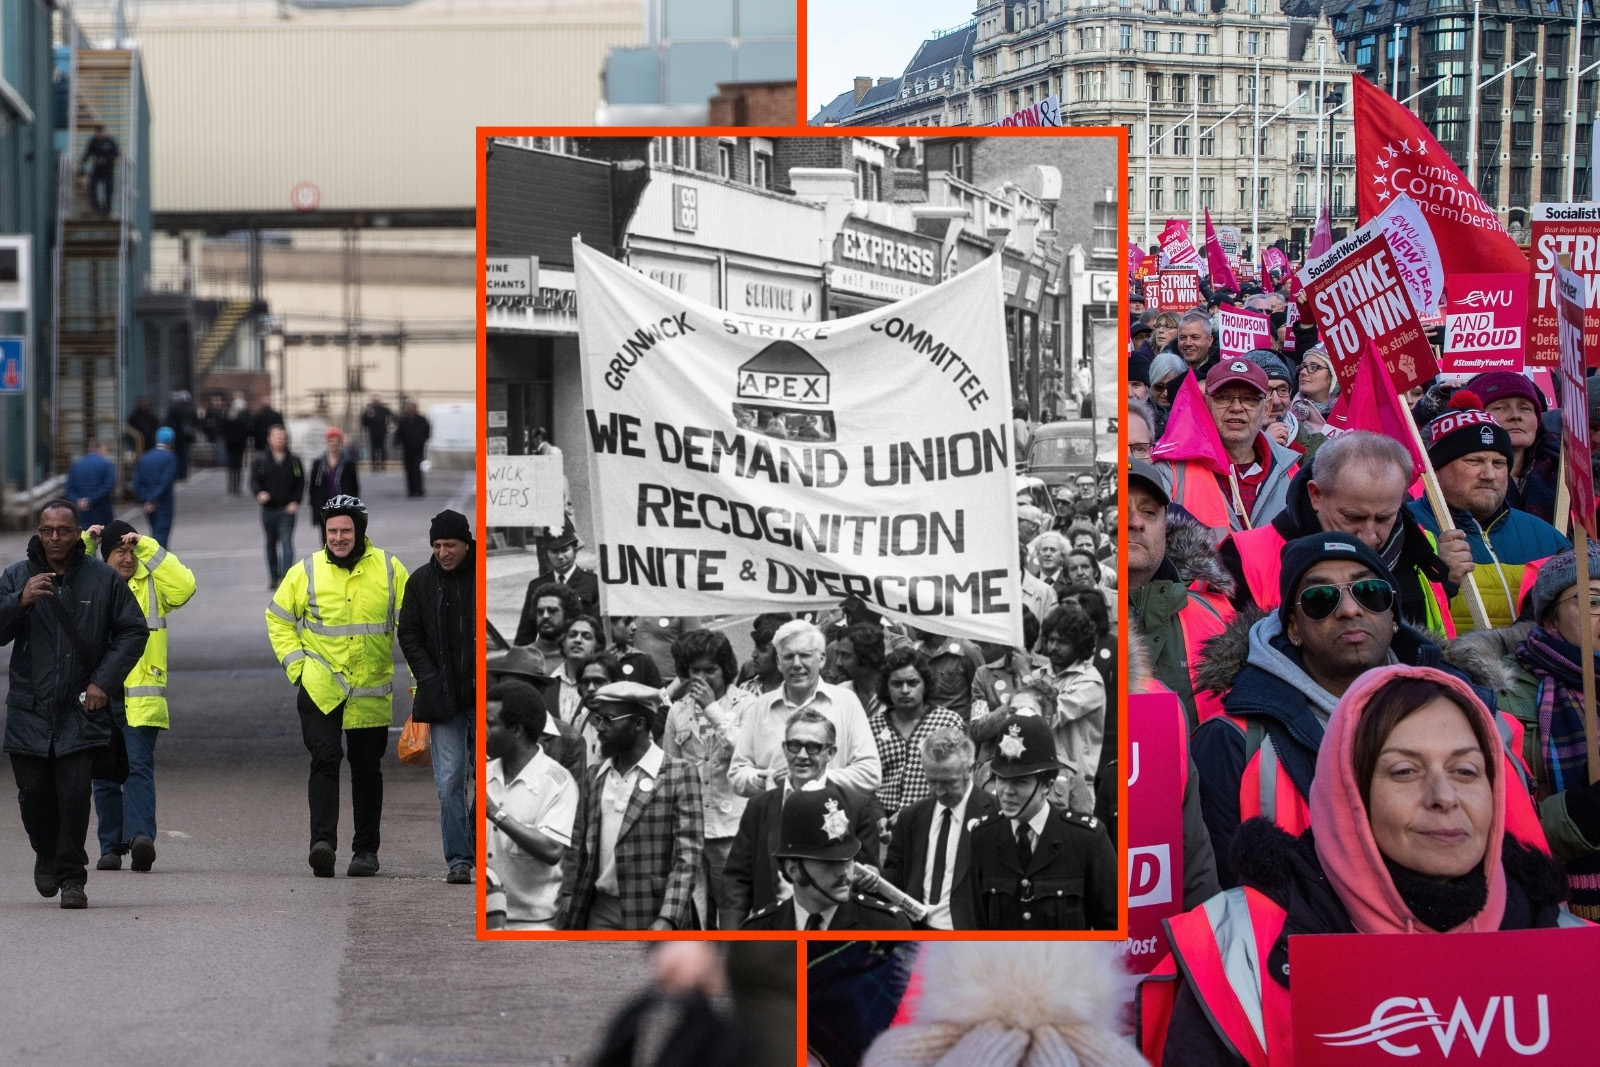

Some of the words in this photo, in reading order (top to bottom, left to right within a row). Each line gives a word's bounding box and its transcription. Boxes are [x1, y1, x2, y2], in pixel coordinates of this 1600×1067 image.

[1418, 164, 1458, 185] unite
[1391, 168, 1495, 216] Commu
[1546, 206, 1600, 219] Socialist
[1559, 226, 1577, 234] Royal
[843, 228, 934, 277] EXPRESS
[1169, 241, 1189, 257] PROUD
[1387, 230, 1422, 264] NEW
[1536, 234, 1600, 271] STRI
[486, 280, 526, 289] CHANTS
[1161, 274, 1197, 289] STRIKE
[1315, 249, 1397, 326] STRIKE
[1146, 296, 1159, 309] TO
[1161, 289, 1174, 303] TO
[1177, 289, 1197, 303] WIN
[1460, 290, 1513, 308] CWU
[723, 318, 832, 340] STRIKE
[1221, 313, 1266, 333] THOMPSON
[1325, 318, 1360, 361] TO
[1356, 284, 1412, 341] WIN
[1450, 314, 1490, 333] AND
[1537, 315, 1558, 327] Esca
[1222, 329, 1251, 351] OUT!
[1376, 345, 1389, 357] he
[1389, 328, 1419, 351] strikes
[1451, 330, 1517, 349] PROUD
[1536, 333, 1558, 346] Defe
[870, 317, 990, 412] COMMITTEE
[1453, 358, 1515, 369] #StandByYourPost
[1535, 348, 1559, 361] activ
[586, 408, 646, 459] WE
[654, 421, 848, 489] DEMAND
[863, 424, 1009, 487] UNION
[487, 465, 526, 482] WICK
[488, 487, 530, 508] VERS
[637, 482, 965, 557] RECOGNITION
[600, 543, 727, 592] UNITE
[739, 559, 757, 582] &
[766, 557, 1010, 617] OVERCOME
[1128, 852, 1162, 898] D
[1122, 935, 1158, 956] Post
[1350, 994, 1551, 1059] CWU
